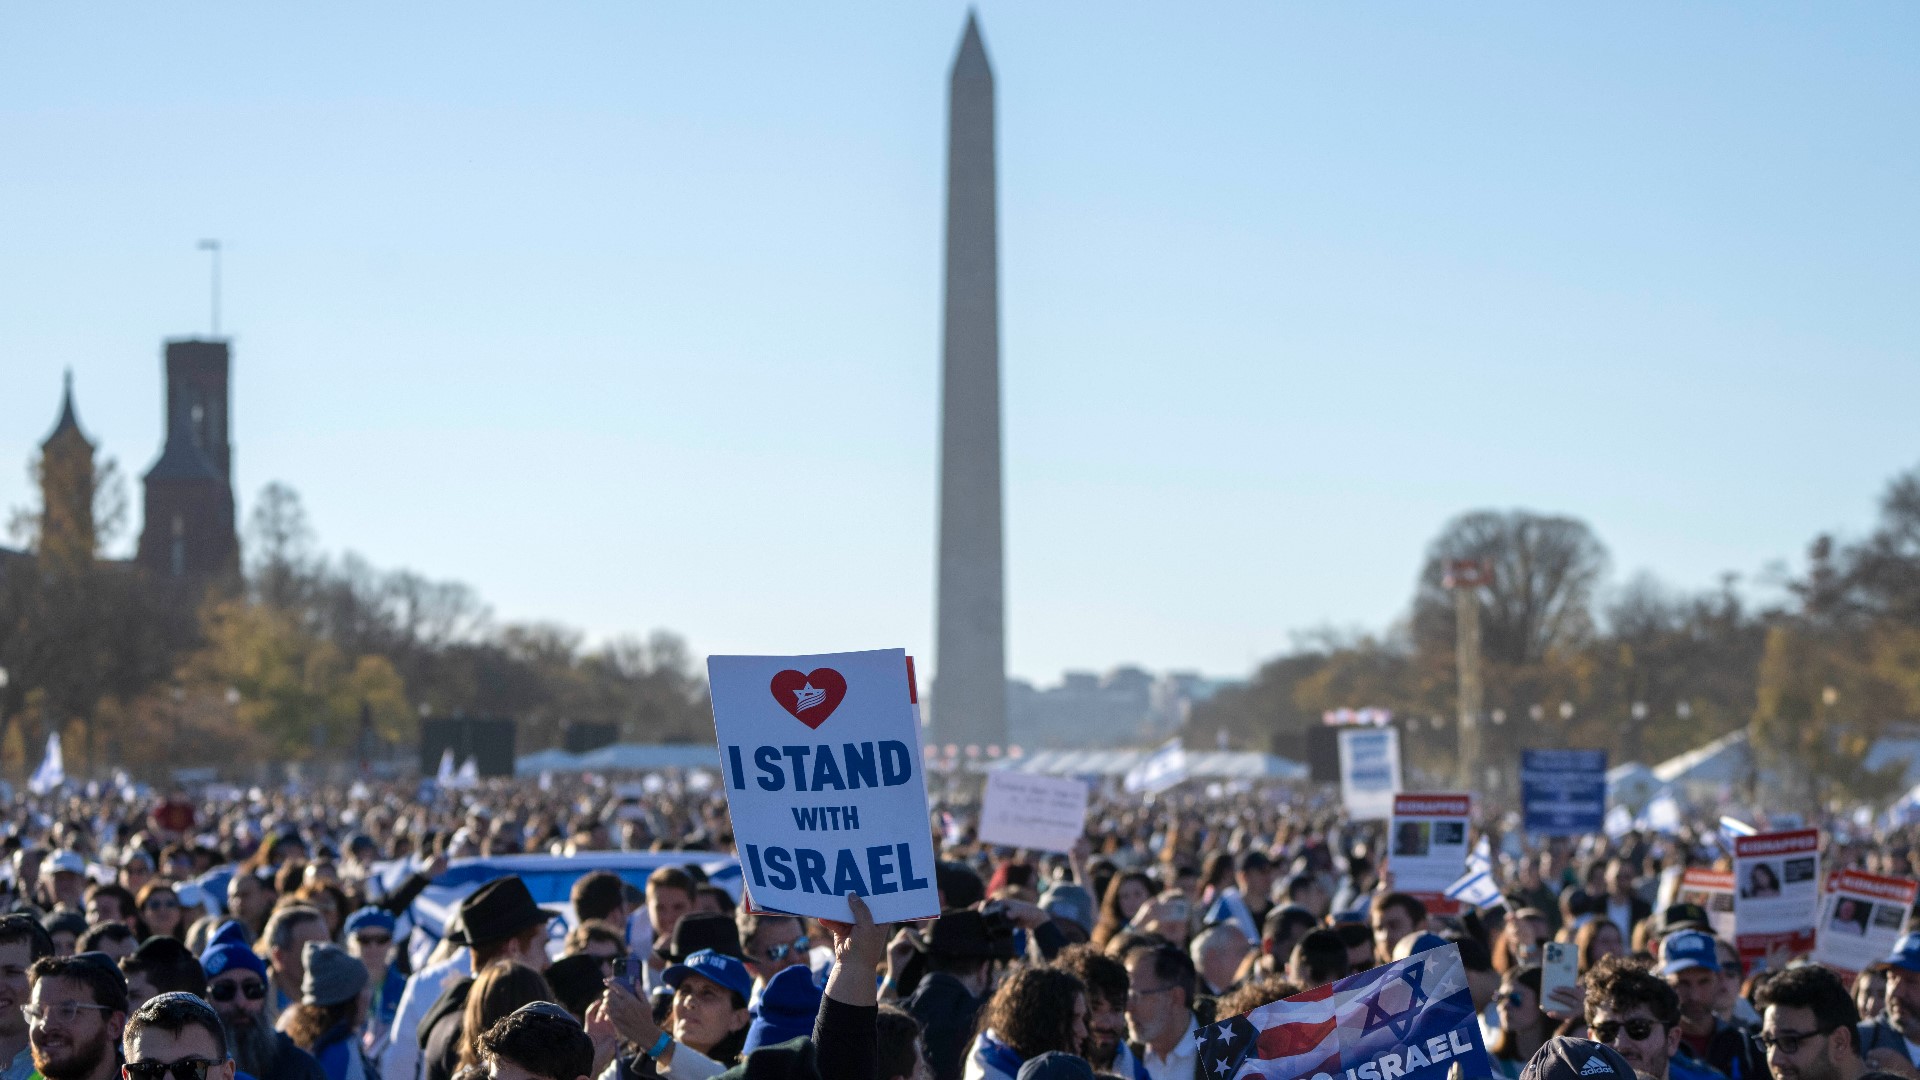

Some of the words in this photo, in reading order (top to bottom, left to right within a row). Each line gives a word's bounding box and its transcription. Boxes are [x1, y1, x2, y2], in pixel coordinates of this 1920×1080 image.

[728, 745, 746, 790] I
[754, 740, 912, 791] STAND
[791, 806, 860, 831] WITH
[745, 843, 929, 897] ISRAEL
[1580, 1065, 1615, 1076] adidas
